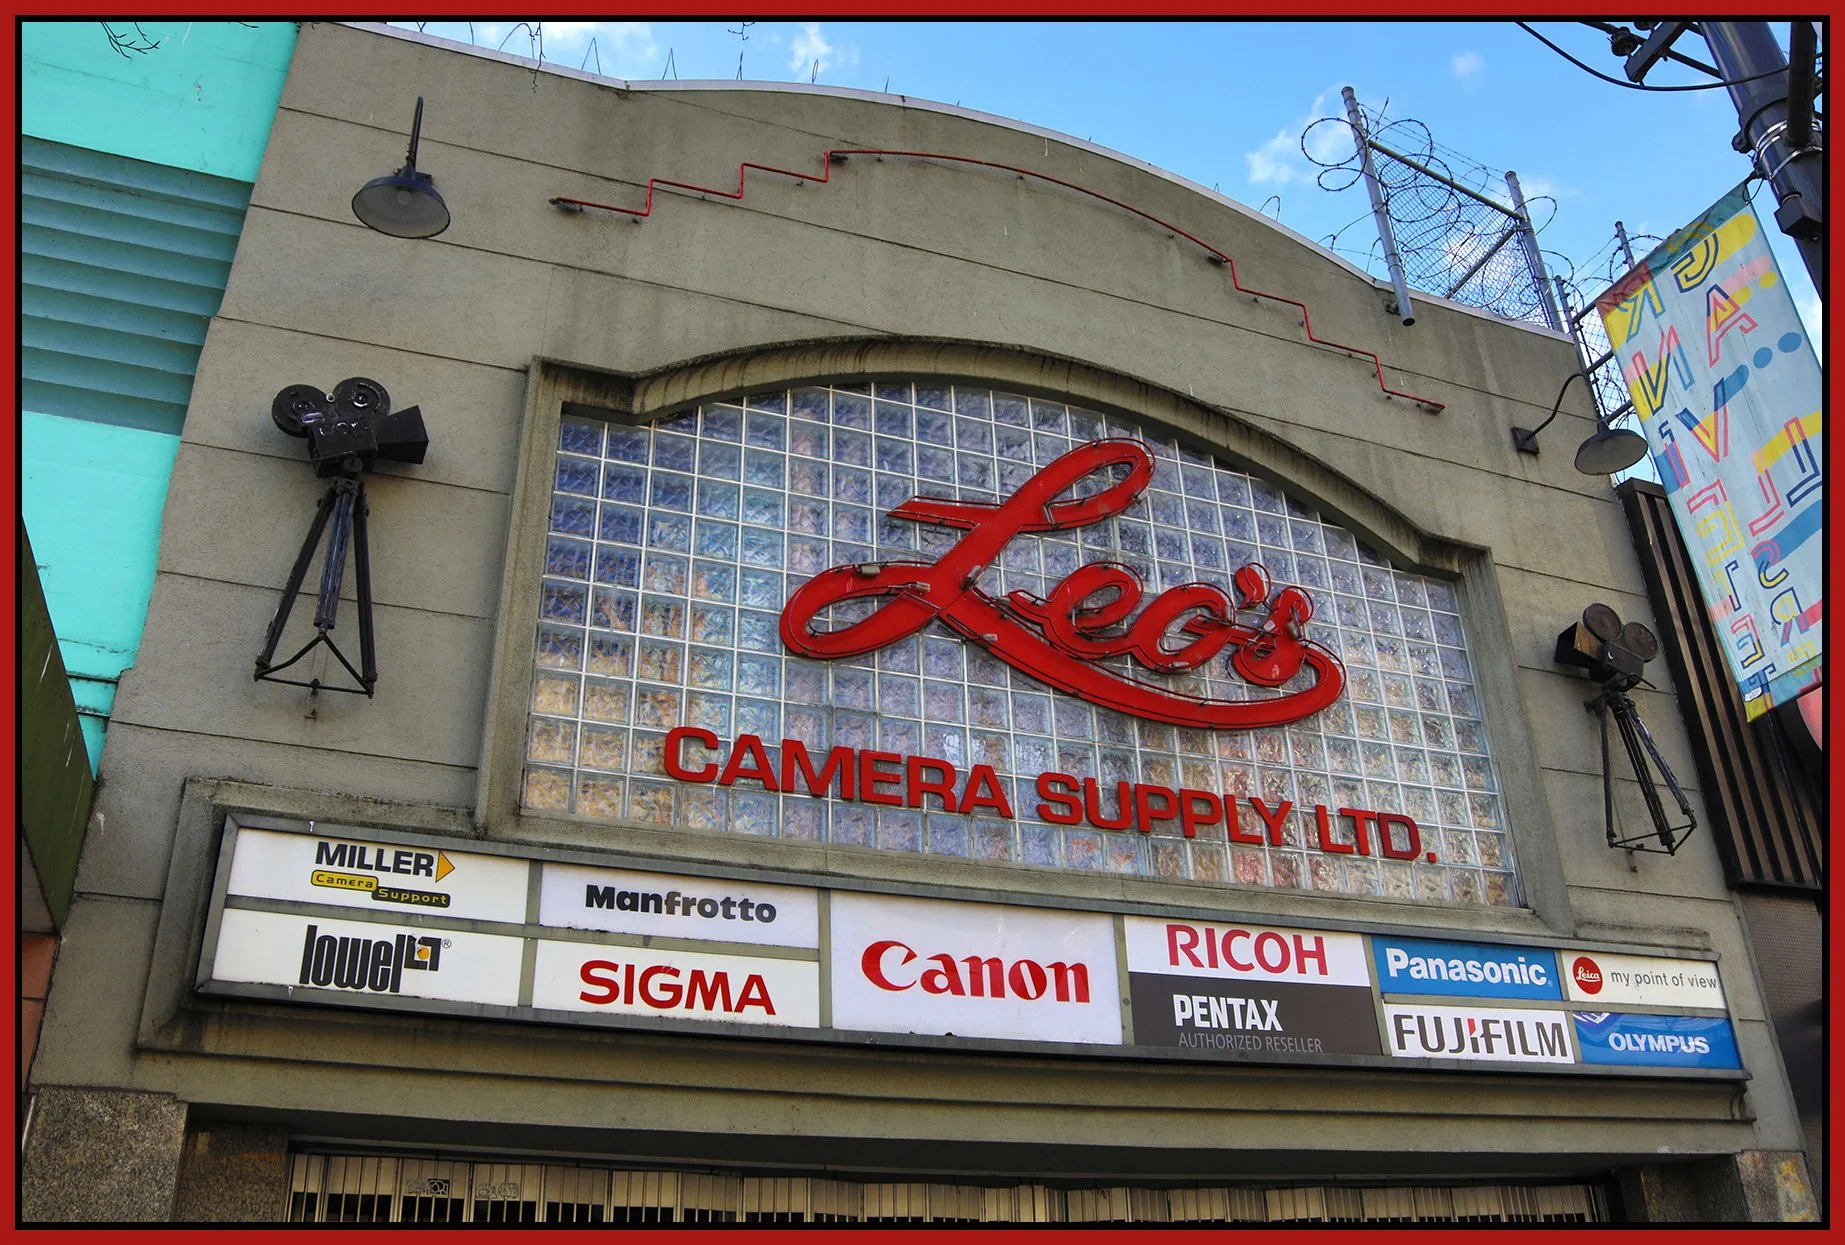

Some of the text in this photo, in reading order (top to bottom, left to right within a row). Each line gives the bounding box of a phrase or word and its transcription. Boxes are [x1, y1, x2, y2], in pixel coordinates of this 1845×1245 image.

[664, 725, 1438, 864] CAMERA SUPPLY LTD.
[315, 841, 434, 877] MILLER
[316, 873, 373, 889] Camera
[378, 888, 447, 905] Support
[585, 884, 777, 924] Manfrotto
[299, 924, 402, 994] lowel
[1166, 924, 1329, 976] RICOH
[1385, 947, 1548, 987] Panasonic
[579, 959, 777, 1016] SIGMA
[861, 940, 1091, 1003] Canon
[1576, 966, 1601, 982] Leica
[1611, 971, 1717, 989] my point of view
[1172, 994, 1284, 1032] PENTAX
[1178, 1032, 1323, 1053] AUTHORIZED RESELLER
[1392, 1013, 1568, 1058] FUJIFILM
[1608, 1032, 1711, 1054] OLYMPUS
